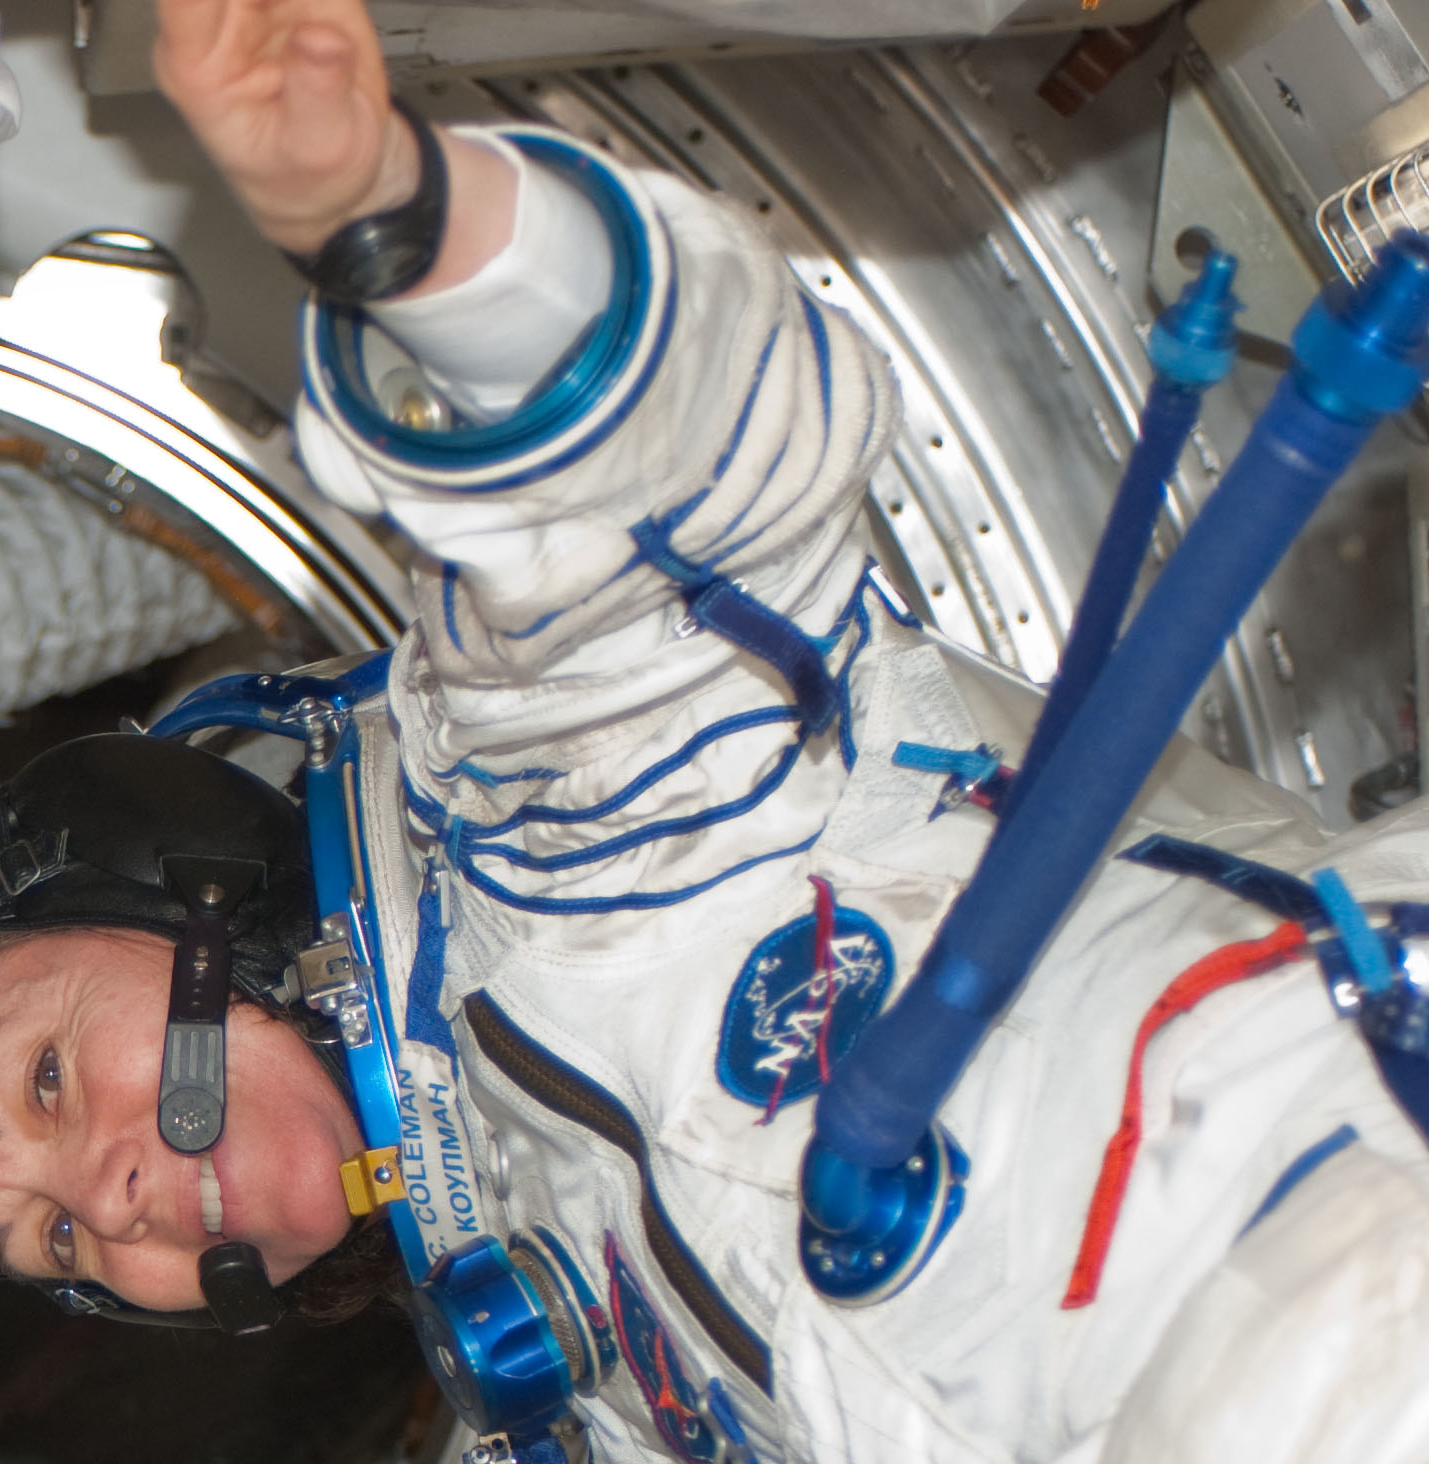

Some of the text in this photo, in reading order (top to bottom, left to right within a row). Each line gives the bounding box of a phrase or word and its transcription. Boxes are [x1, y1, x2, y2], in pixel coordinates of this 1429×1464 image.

[753, 933, 869, 1077] NASA
[397, 1067, 437, 1226] COLEMAN
[427, 1081, 479, 1233] КОУЛМАН
